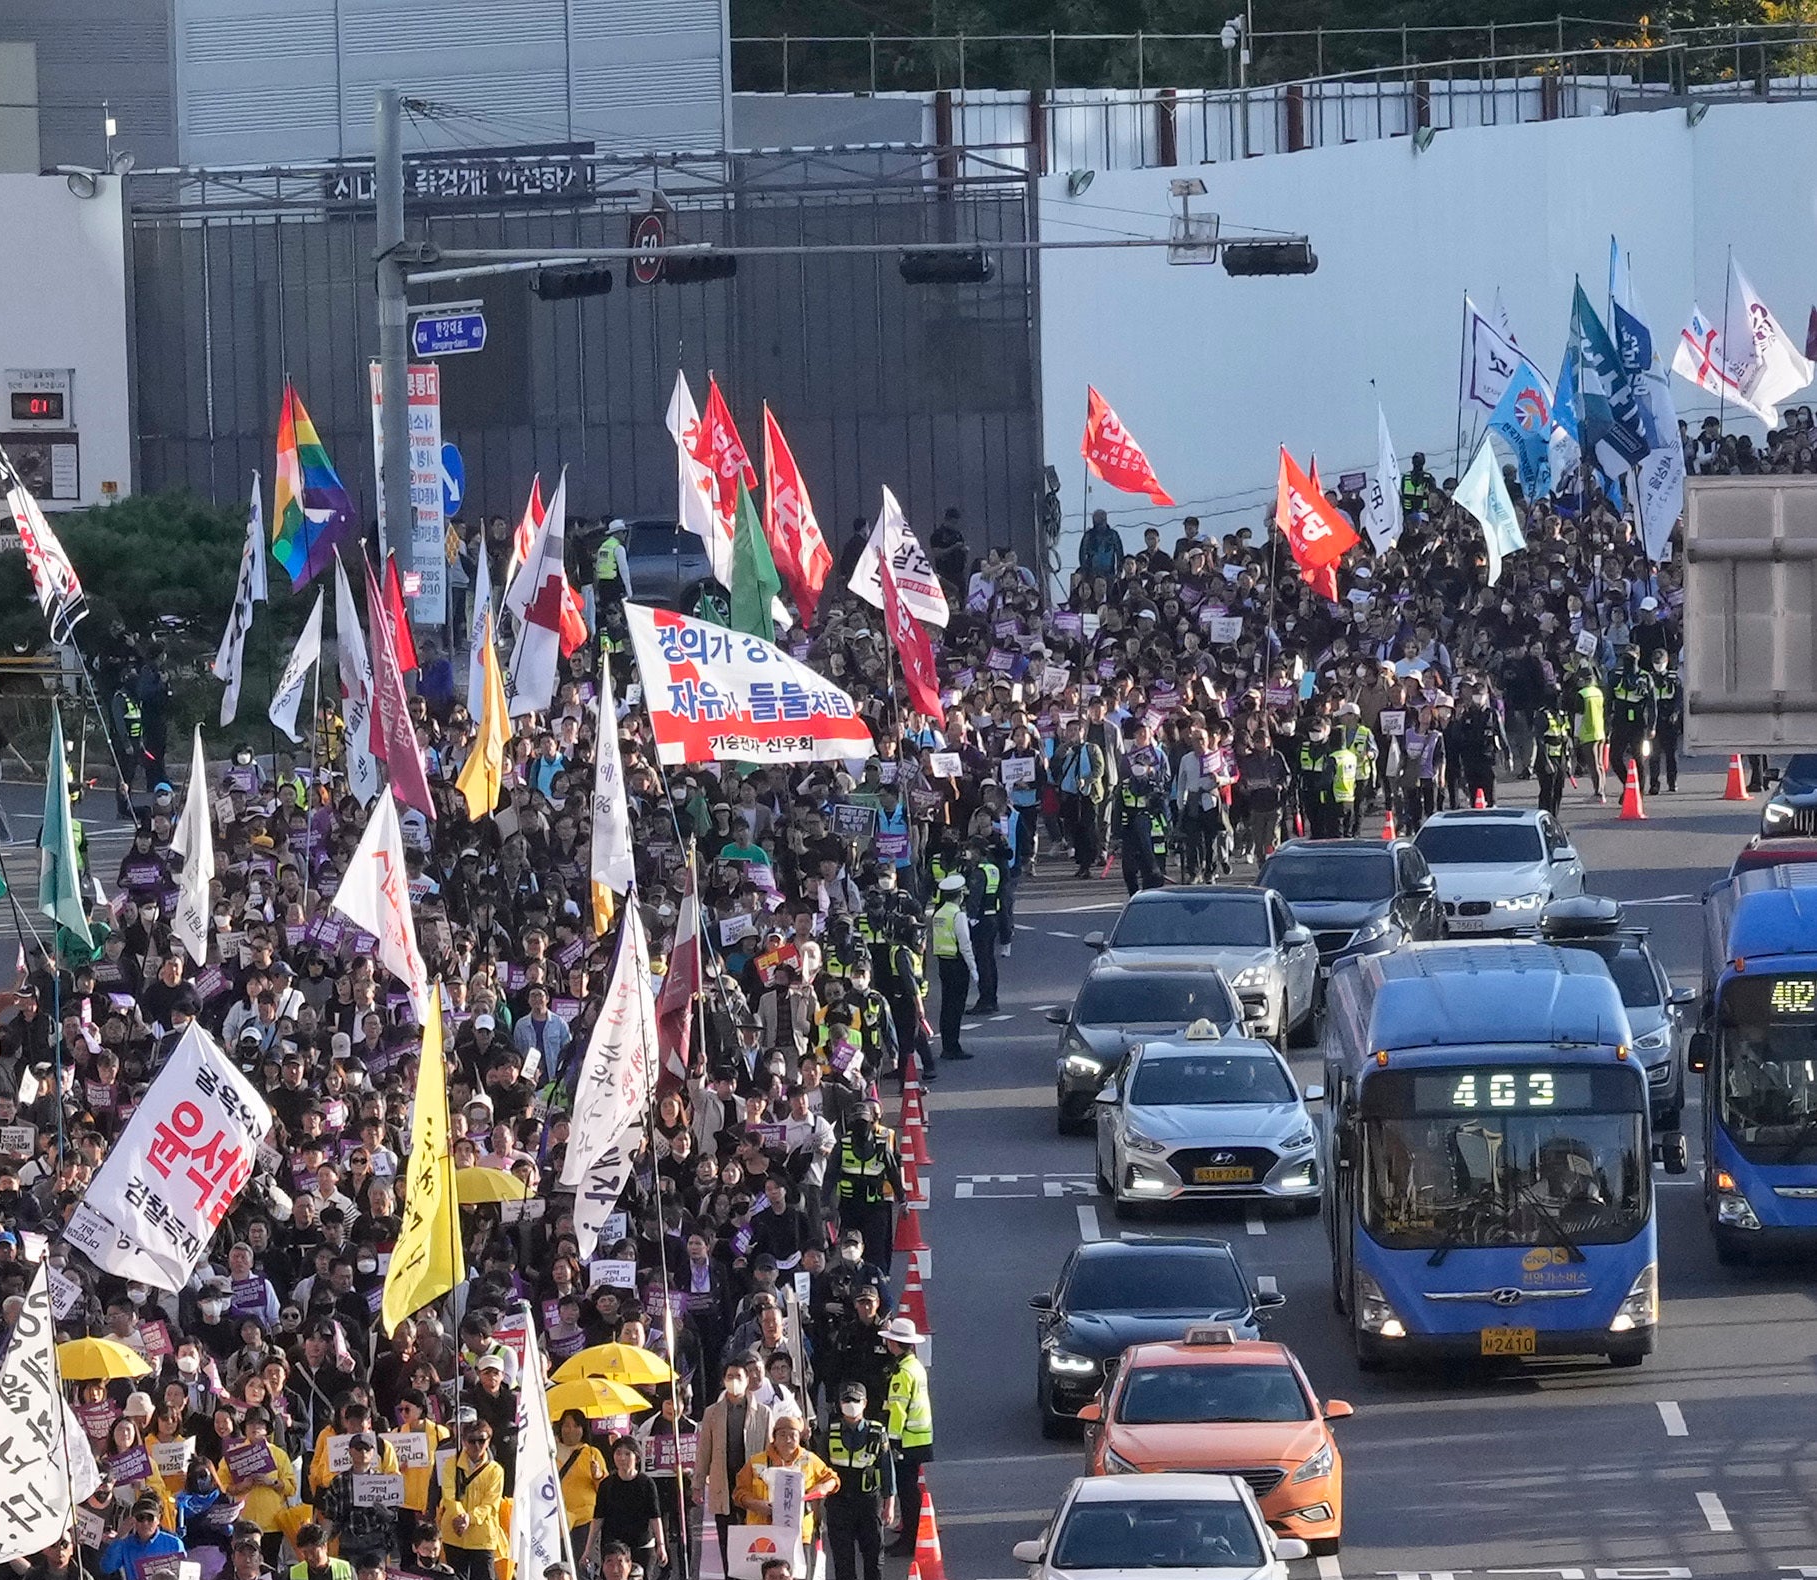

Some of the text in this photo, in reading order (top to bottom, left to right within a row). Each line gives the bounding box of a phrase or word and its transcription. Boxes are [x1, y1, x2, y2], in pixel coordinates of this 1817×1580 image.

[334, 170, 377, 201] 신나
[435, 320, 464, 337] 한강대로
[656, 627, 732, 665] 정의가
[667, 680, 853, 722] 자유가 들불처럼
[709, 735, 814, 755] 기승전자 신우회
[125, 1175, 203, 1264] 검찰독재
[1494, 1337, 1533, 1353] 2410
